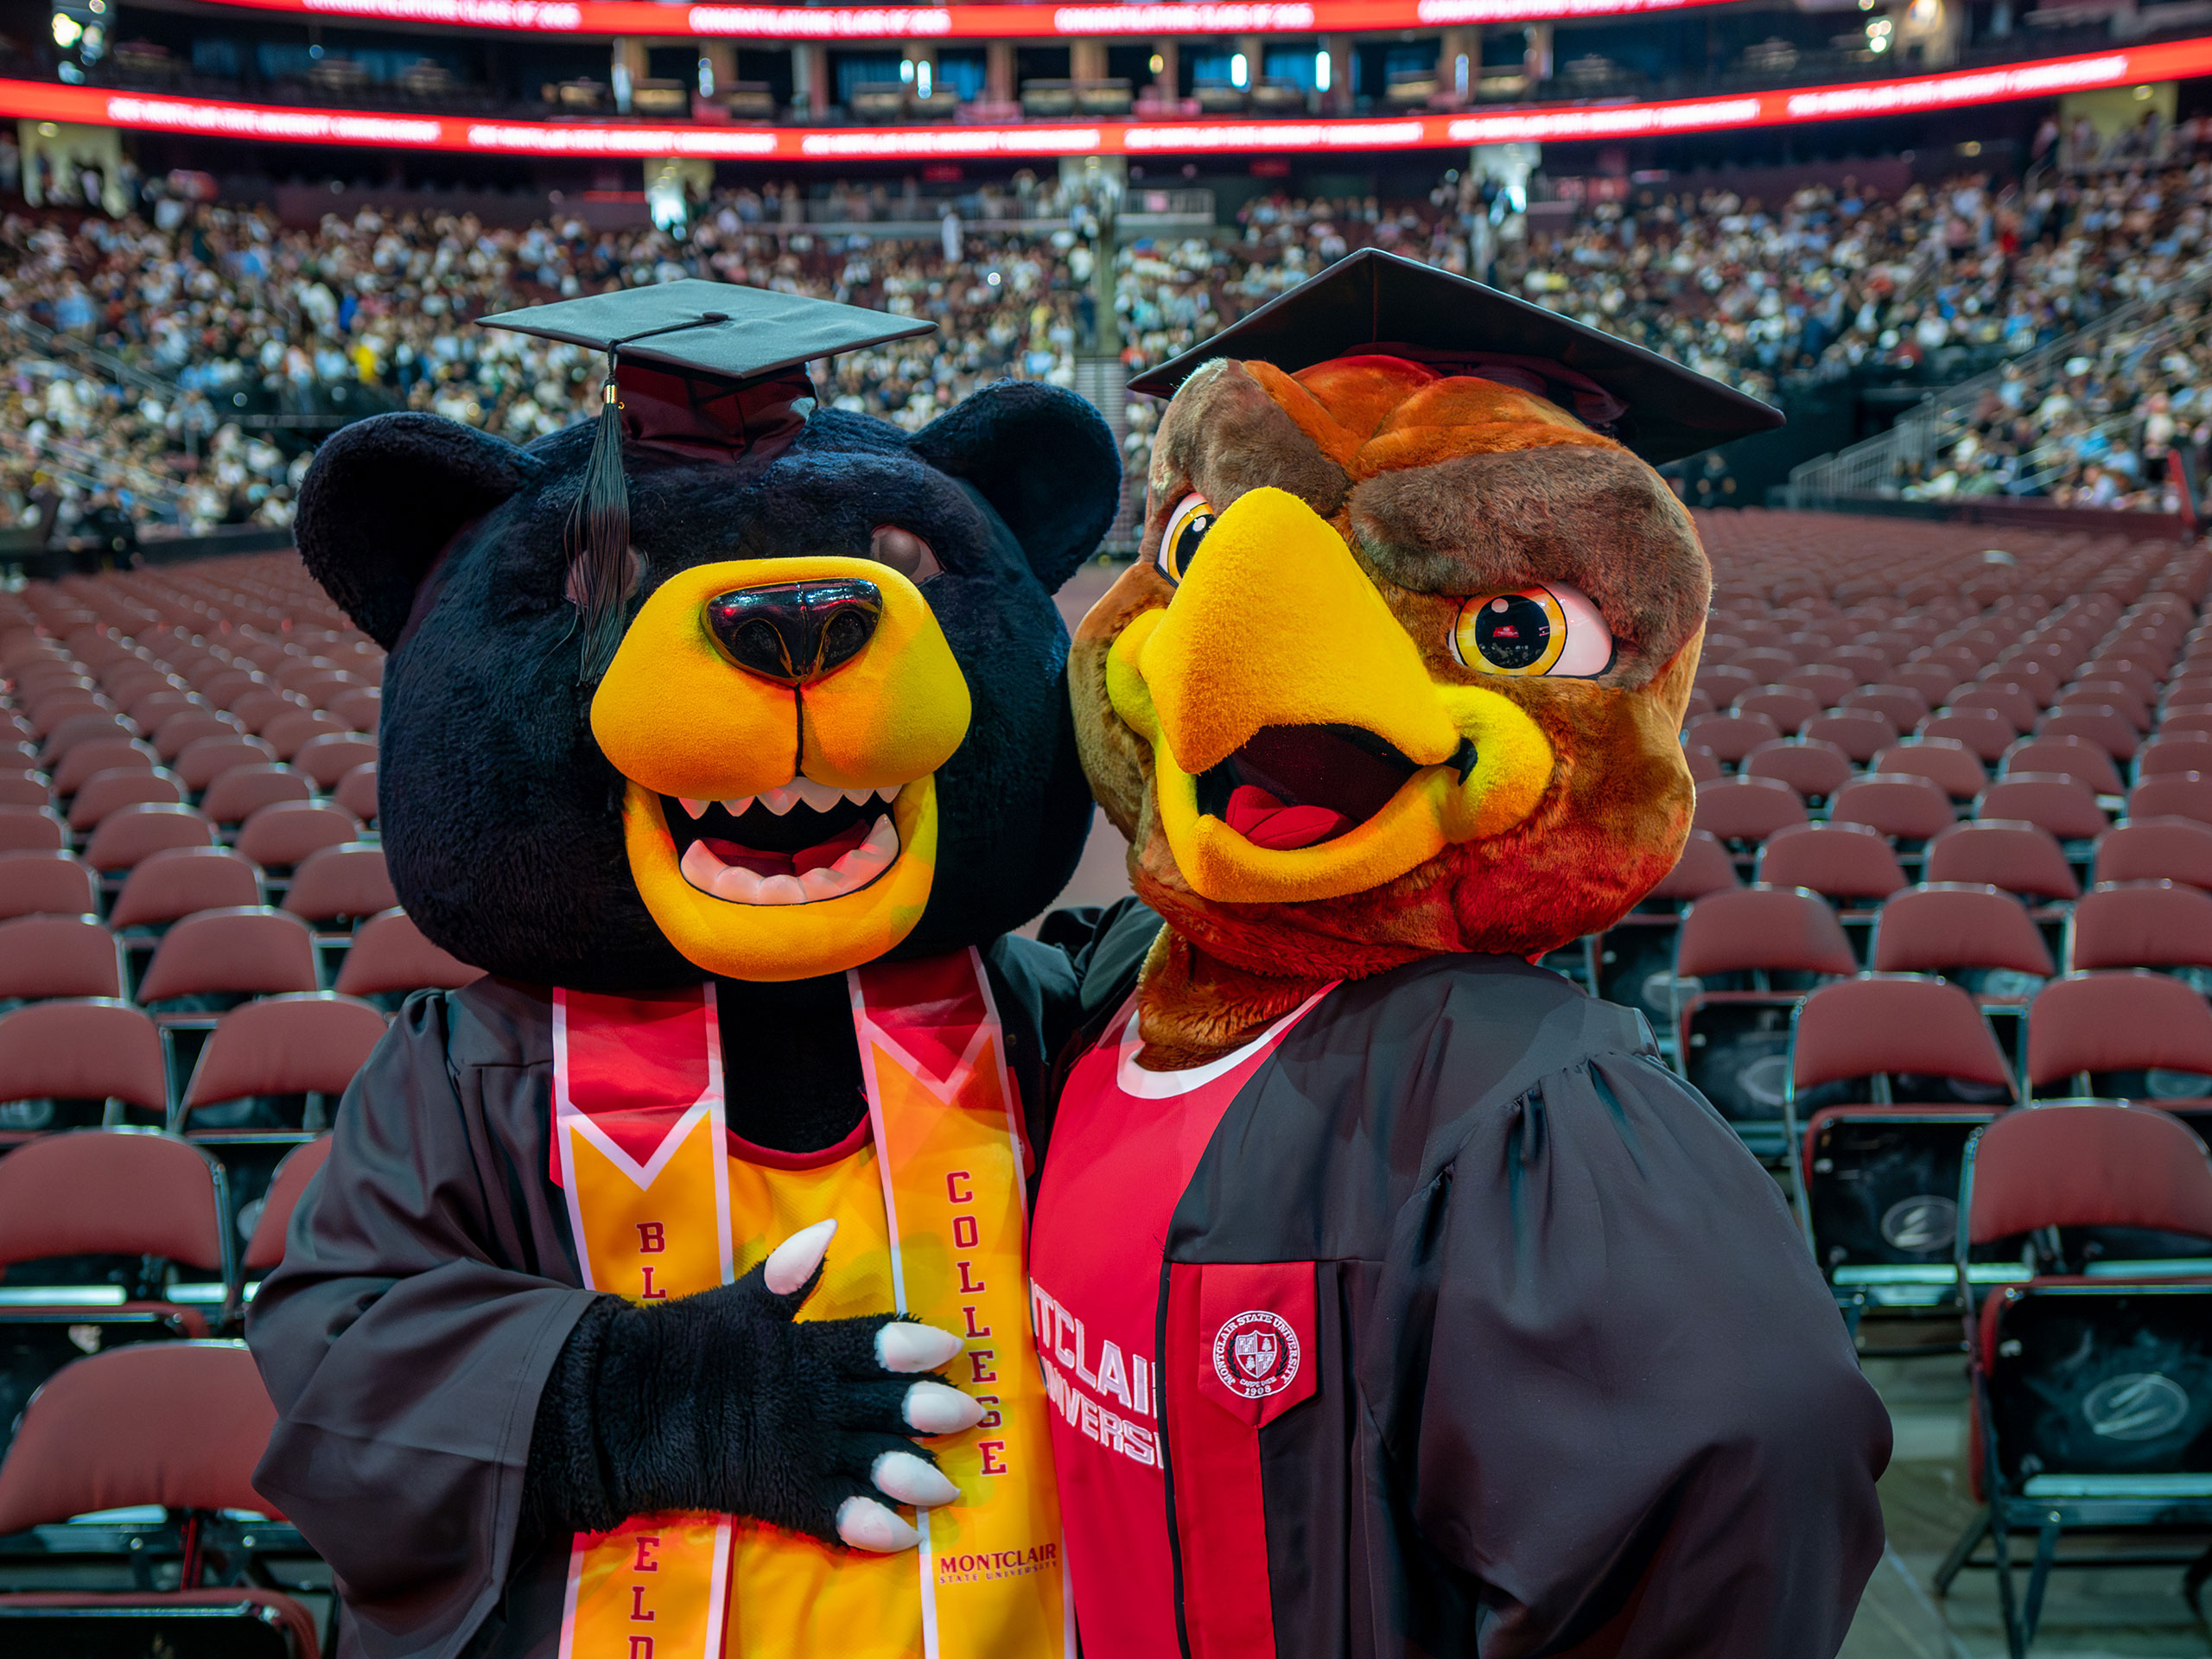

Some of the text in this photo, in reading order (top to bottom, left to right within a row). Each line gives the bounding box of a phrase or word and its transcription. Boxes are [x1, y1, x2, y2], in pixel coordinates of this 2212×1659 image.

[946, 1171, 1007, 1477] COLLEGE
[1030, 1276, 1158, 1420] TCLAI
[1216, 1313, 1298, 1386] MONTCLAIR STATE UNIVERSITY
[1244, 1385, 1272, 1396] 1908
[939, 1560, 1058, 1585] STATE UNIVERSITY
[940, 1542, 1057, 1574] MONTCLAIR
